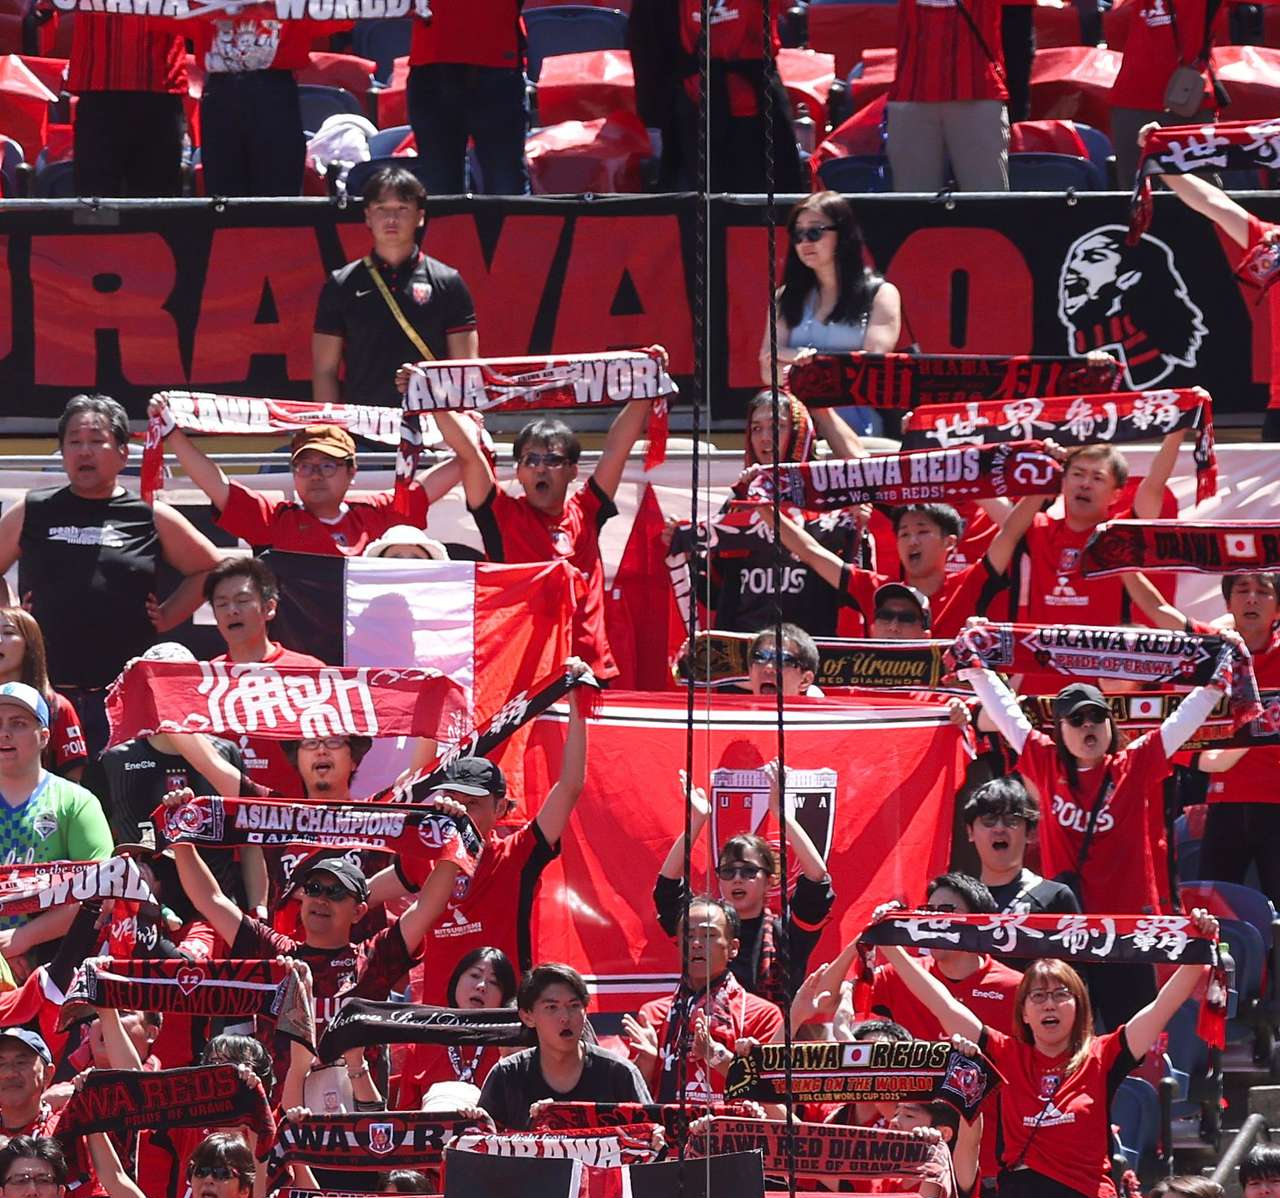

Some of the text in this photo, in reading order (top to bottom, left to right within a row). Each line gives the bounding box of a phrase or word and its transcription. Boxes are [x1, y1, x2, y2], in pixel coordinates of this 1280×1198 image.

[929, 390, 1185, 446] 世界制覇
[812, 450, 980, 492] URAWA REDS
[849, 484, 945, 502] We are REDS!
[1155, 532, 1220, 569] URAWA
[1038, 627, 1201, 655] URAWA REDS
[824, 652, 927, 677] of Urawa
[124, 761, 156, 771] EneCle
[235, 805, 404, 837] ASIAN CHAMPIONS
[897, 915, 1192, 958] 世界制覇
[872, 1042, 946, 1070] REDS
[824, 1077, 842, 1091] ON
[846, 1076, 871, 1091] THE
[875, 1074, 932, 1090] WORLD!
